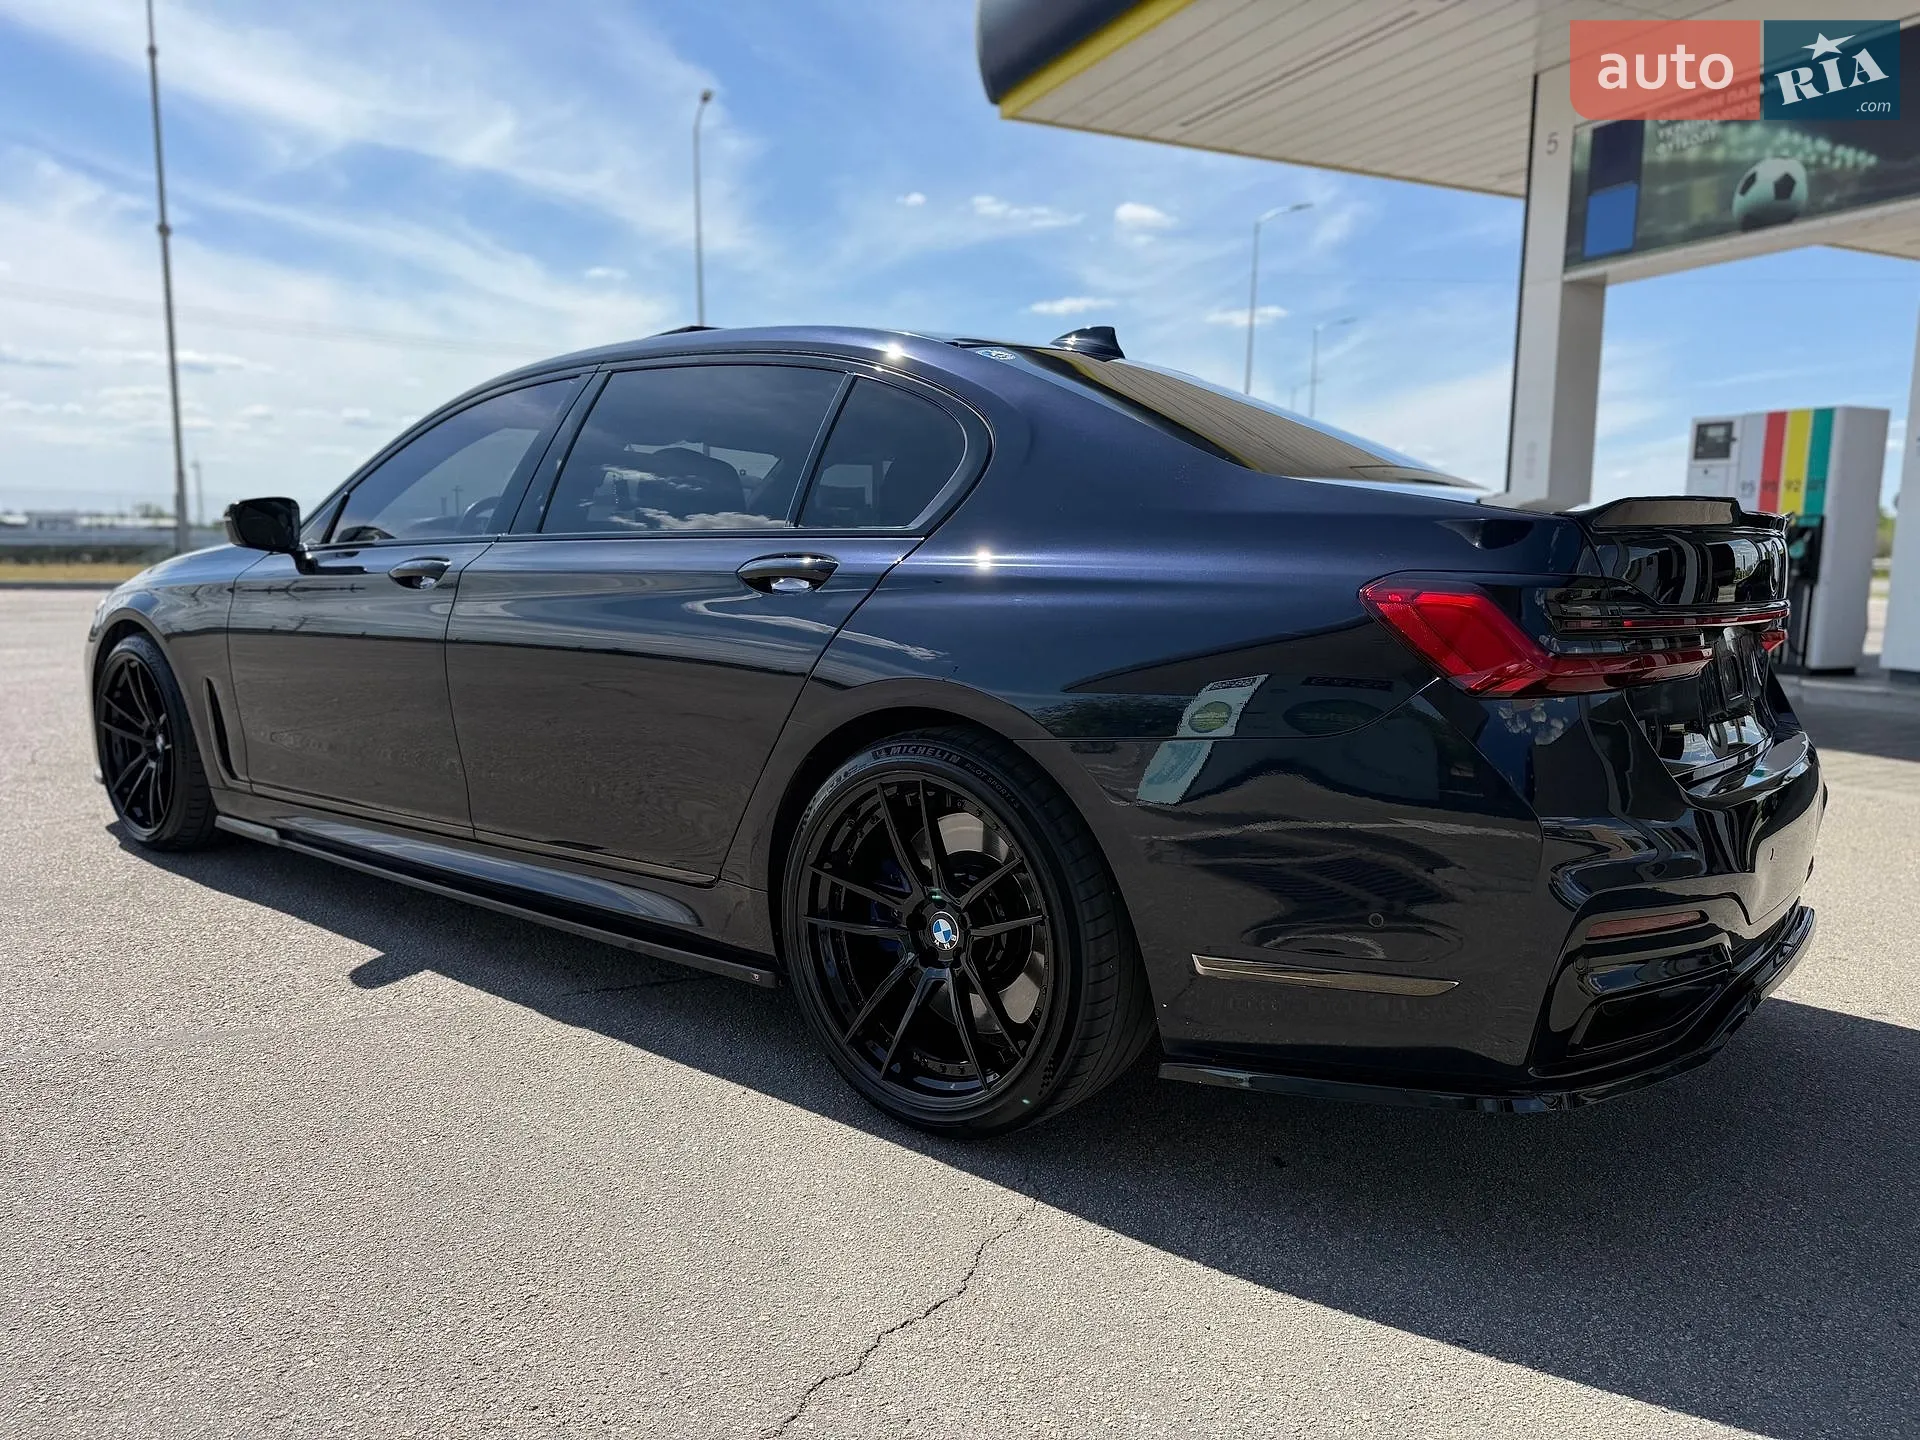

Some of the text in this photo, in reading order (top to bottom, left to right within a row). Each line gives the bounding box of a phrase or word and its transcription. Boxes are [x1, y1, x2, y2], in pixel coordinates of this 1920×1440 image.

[1546, 131, 1559, 156] 5
[889, 746, 961, 764] MICHELIN
[965, 762, 988, 779] PILOT
